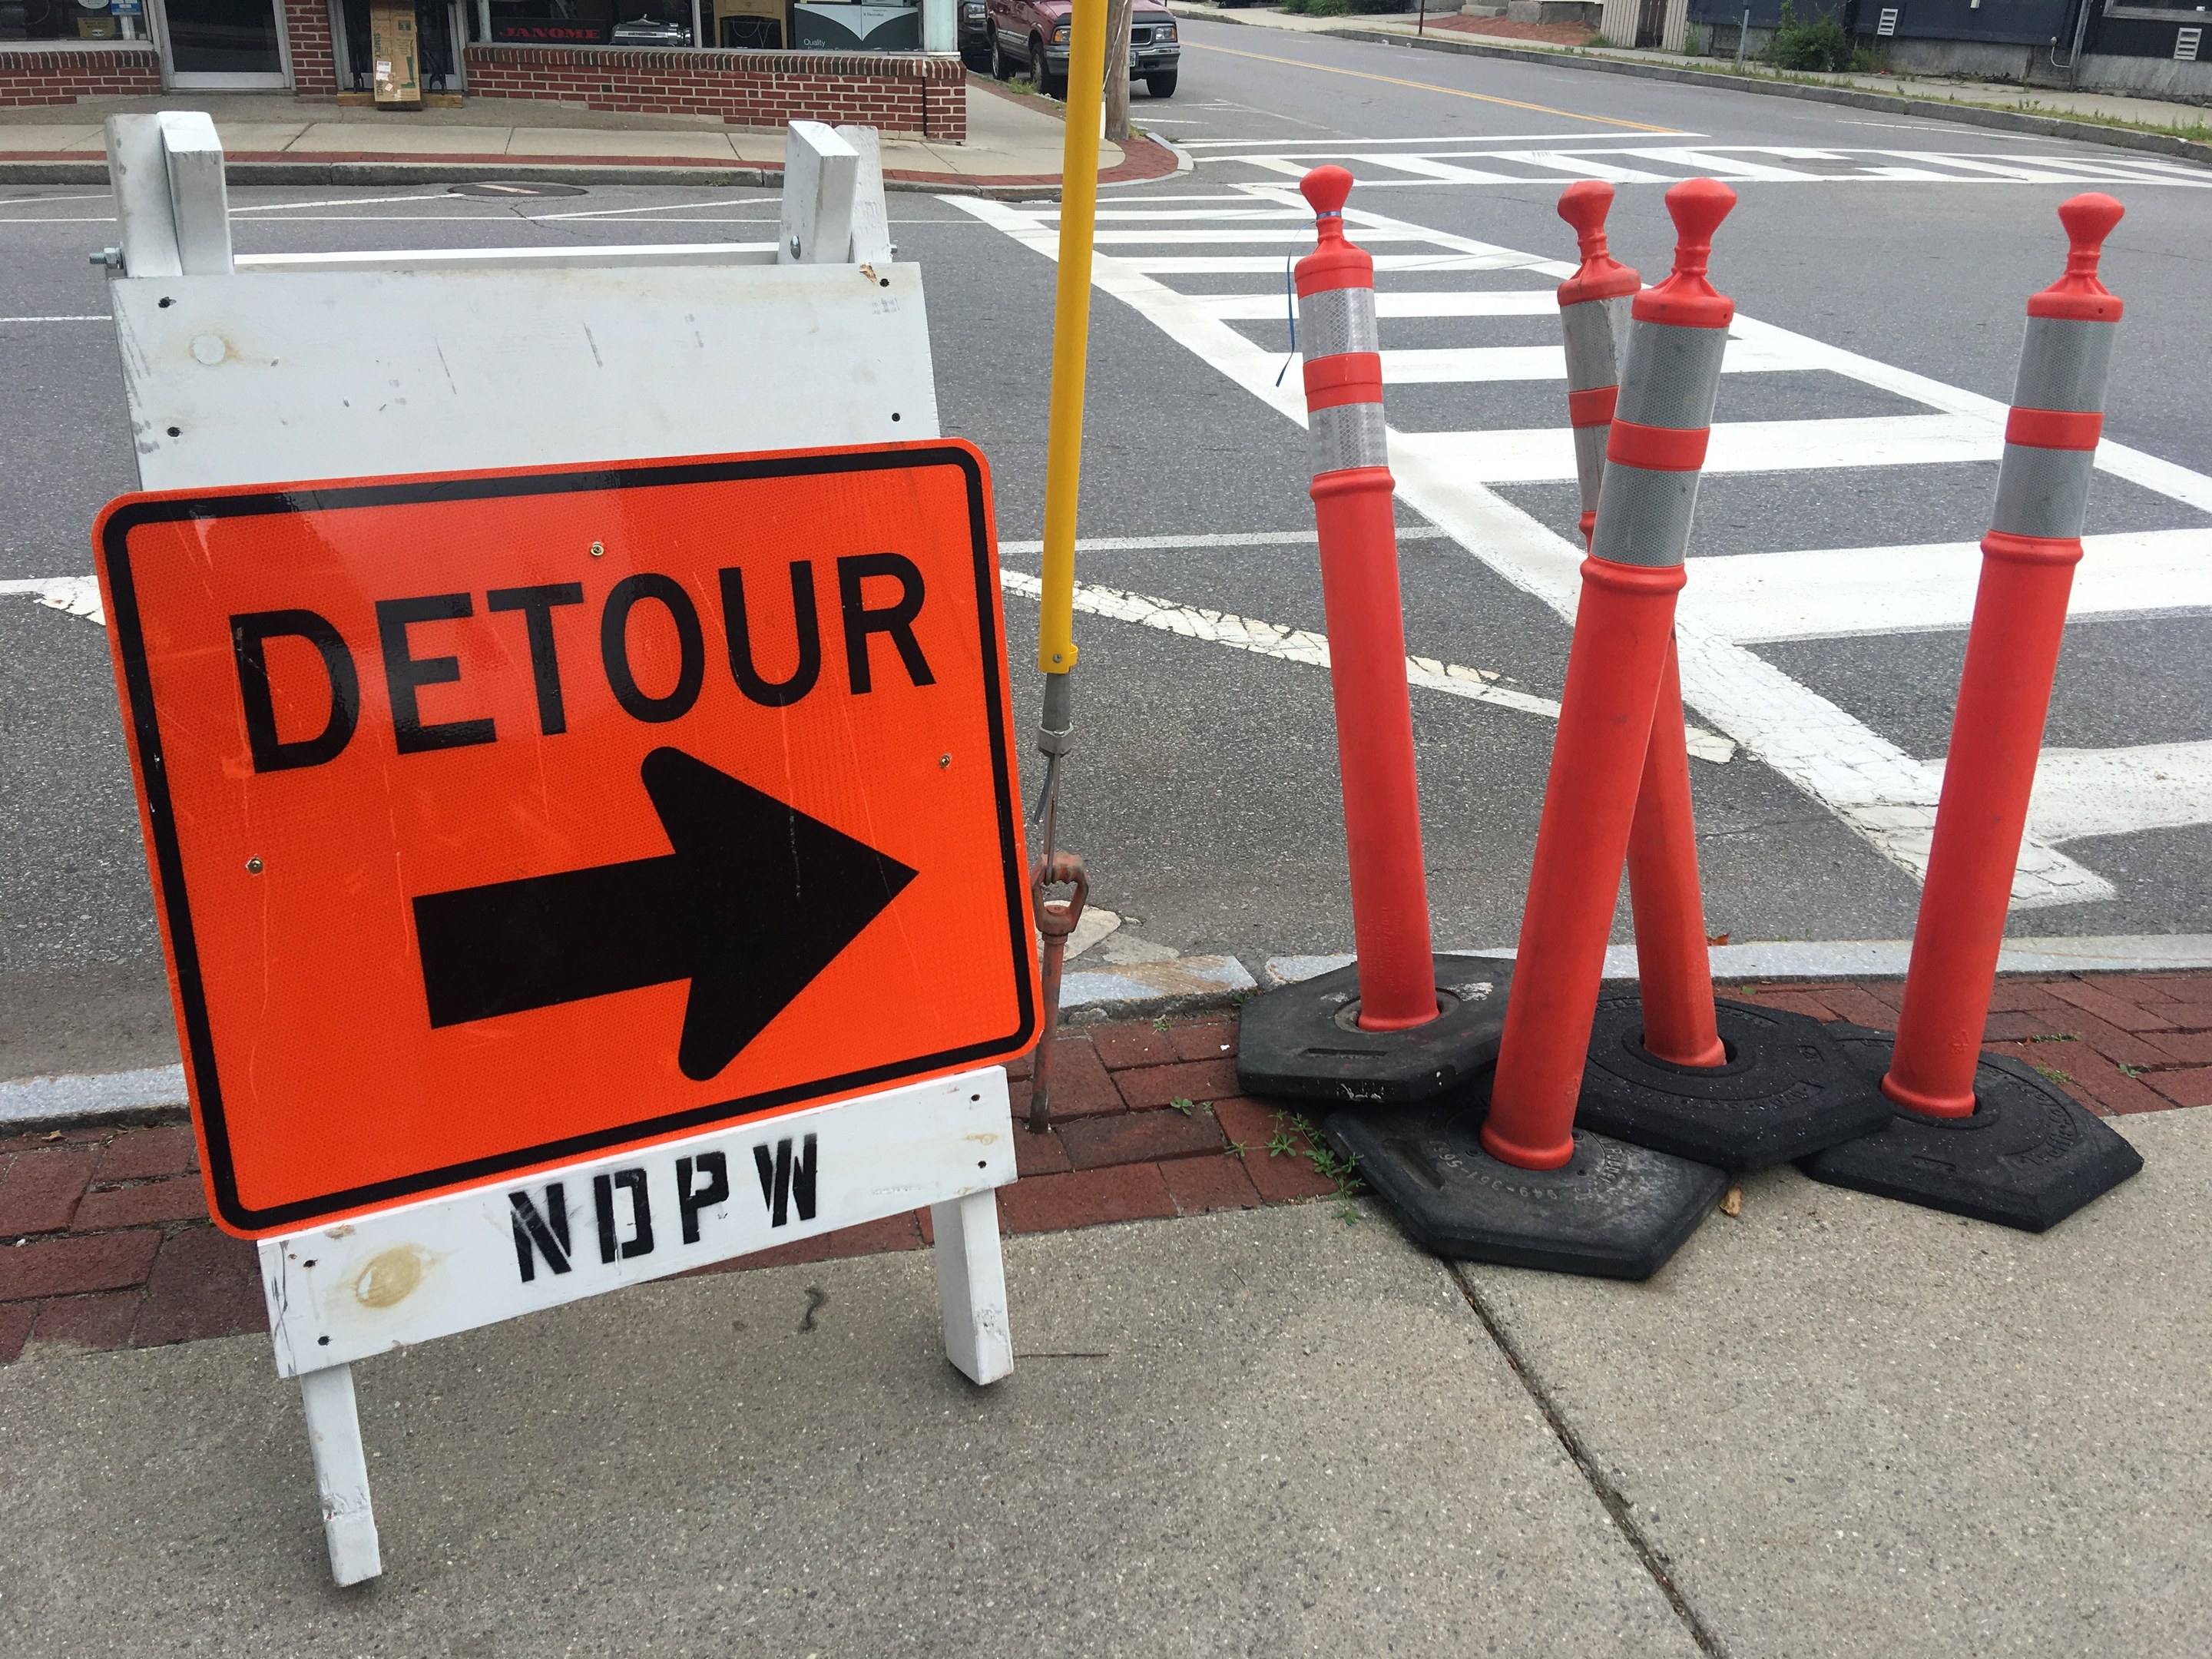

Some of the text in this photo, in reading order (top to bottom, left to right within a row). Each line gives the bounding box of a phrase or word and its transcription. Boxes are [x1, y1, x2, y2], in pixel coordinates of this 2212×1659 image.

[499, 28, 601, 39] JANOME
[803, 38, 826, 47] Quality
[229, 552, 936, 773] DETOUR
[508, 1133, 817, 1283] NDPW
